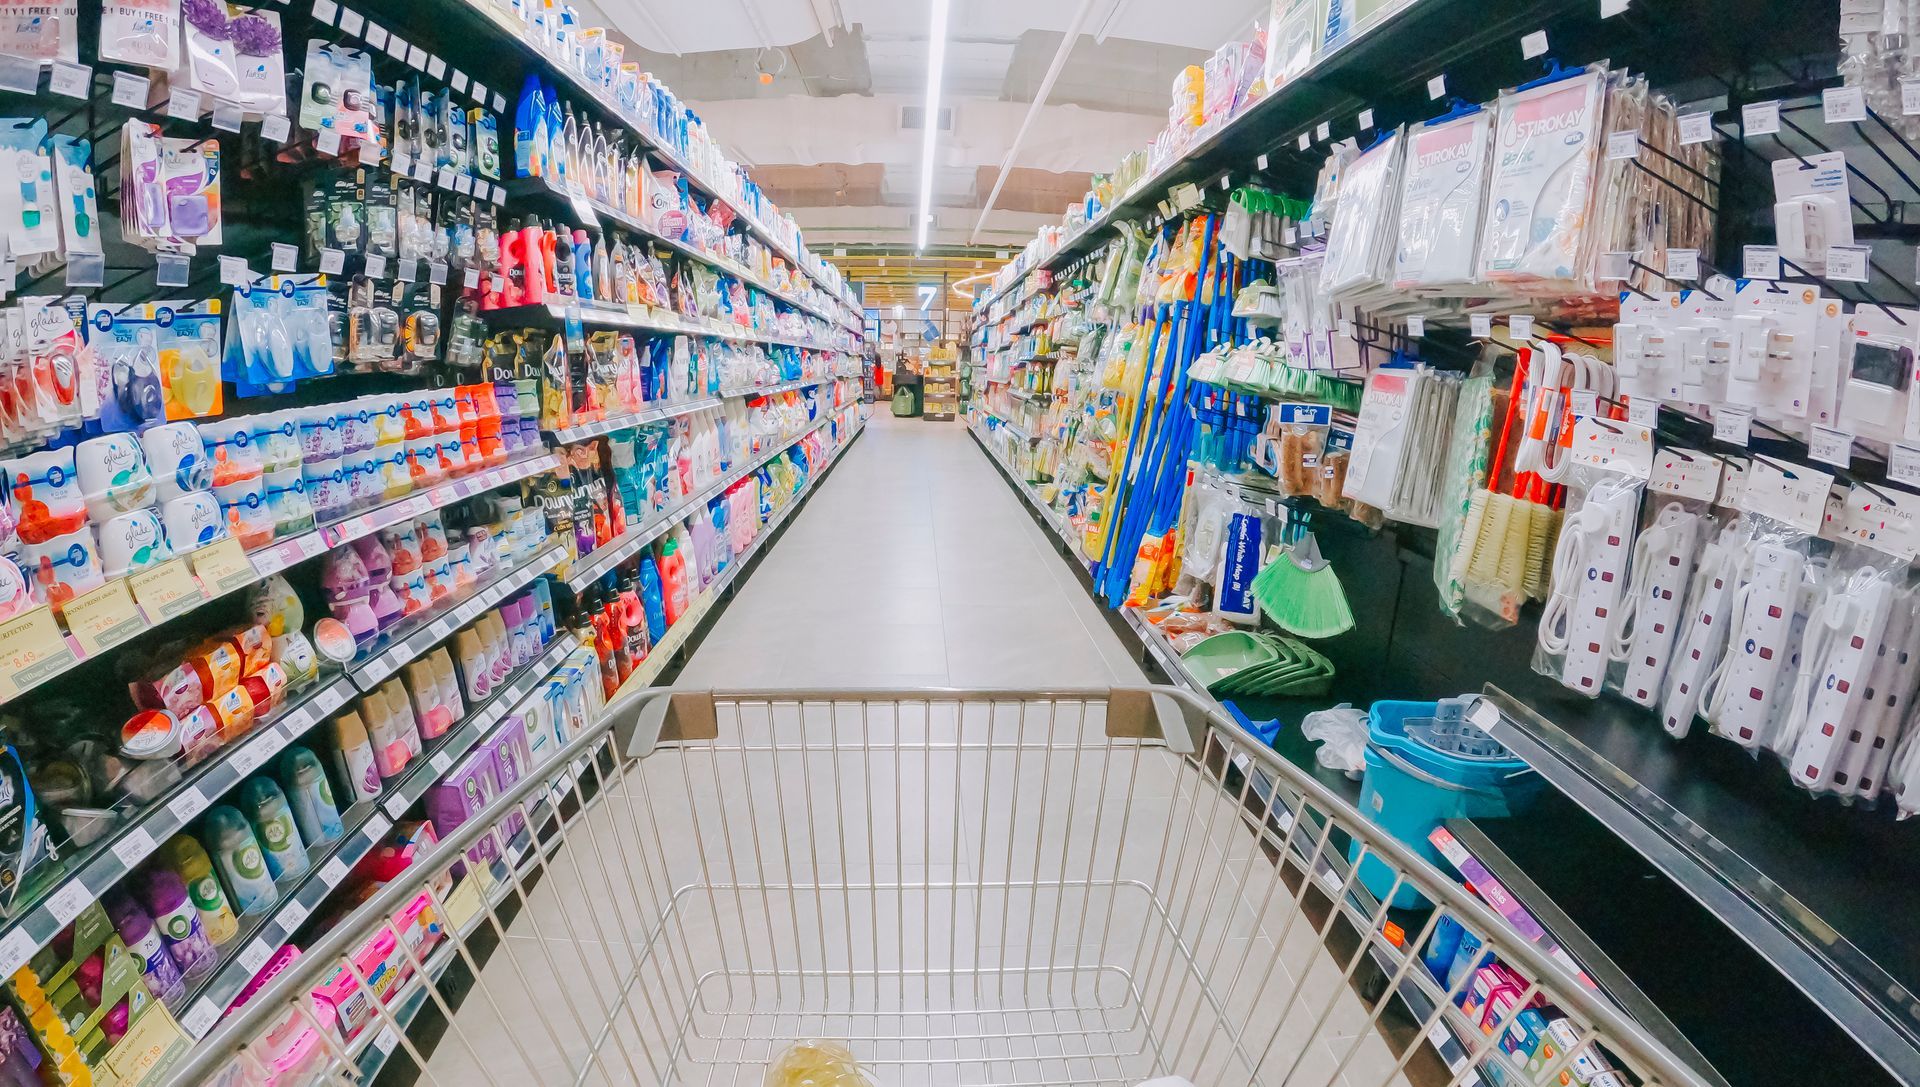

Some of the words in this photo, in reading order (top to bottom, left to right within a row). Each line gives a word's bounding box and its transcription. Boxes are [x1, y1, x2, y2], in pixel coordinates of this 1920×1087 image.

[119, 8, 135, 16] BUY
[145, 12, 164, 22] FREE
[1515, 108, 1584, 139] STIROKAY
[1418, 141, 1472, 169] STIROKAY
[918, 286, 937, 311] 7
[30, 311, 63, 337] glade
[104, 449, 131, 472] glade
[1873, 503, 1913, 520] ZEATAR
[125, 524, 152, 549] glade
[1236, 540, 1246, 562] White
[1233, 563, 1243, 580] Mop
[95, 617, 113, 631] 8.49
[13, 650, 36, 668] 8.49
[1549, 1027, 1568, 1050] PHILIPS
[141, 1045, 161, 1068] 15.39
